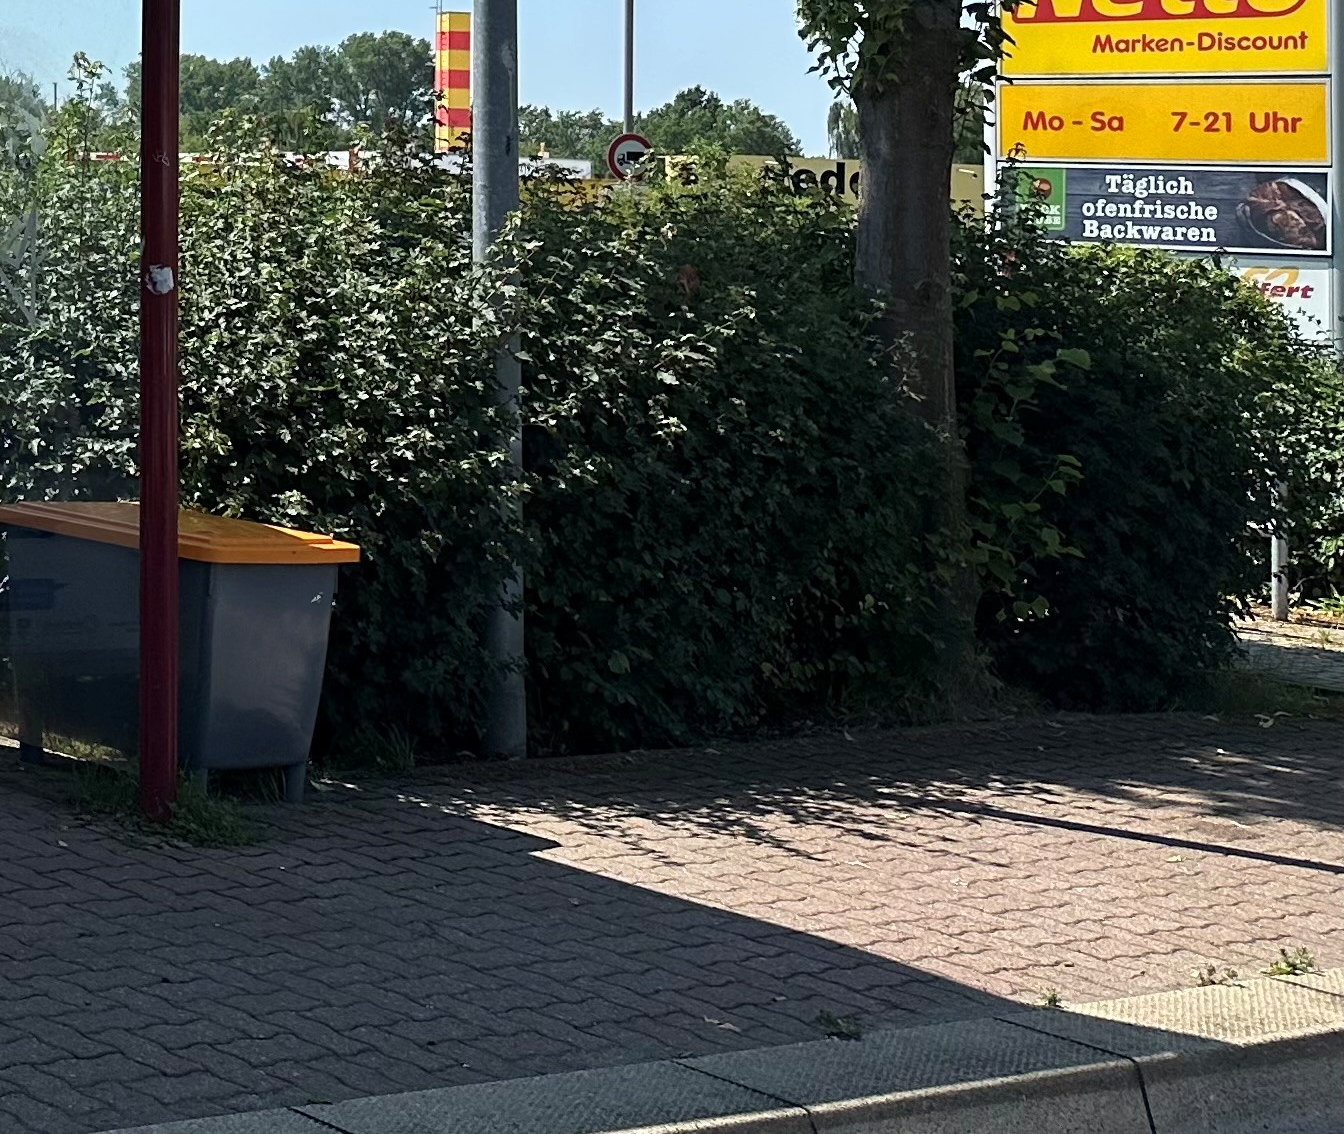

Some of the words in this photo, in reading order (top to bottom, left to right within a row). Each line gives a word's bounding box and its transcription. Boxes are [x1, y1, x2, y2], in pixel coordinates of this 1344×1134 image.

[1092, 32, 1308, 54] Marken-Discount
[1022, 112, 1064, 132] Mo
[1090, 111, 1124, 132] Sa
[1171, 112, 1231, 132] 7-21
[1250, 112, 1302, 134] Uhr
[1106, 174, 1194, 198] Täglich
[1082, 199, 1218, 220] ofenfrische
[1082, 220, 1216, 242] Backwaren
